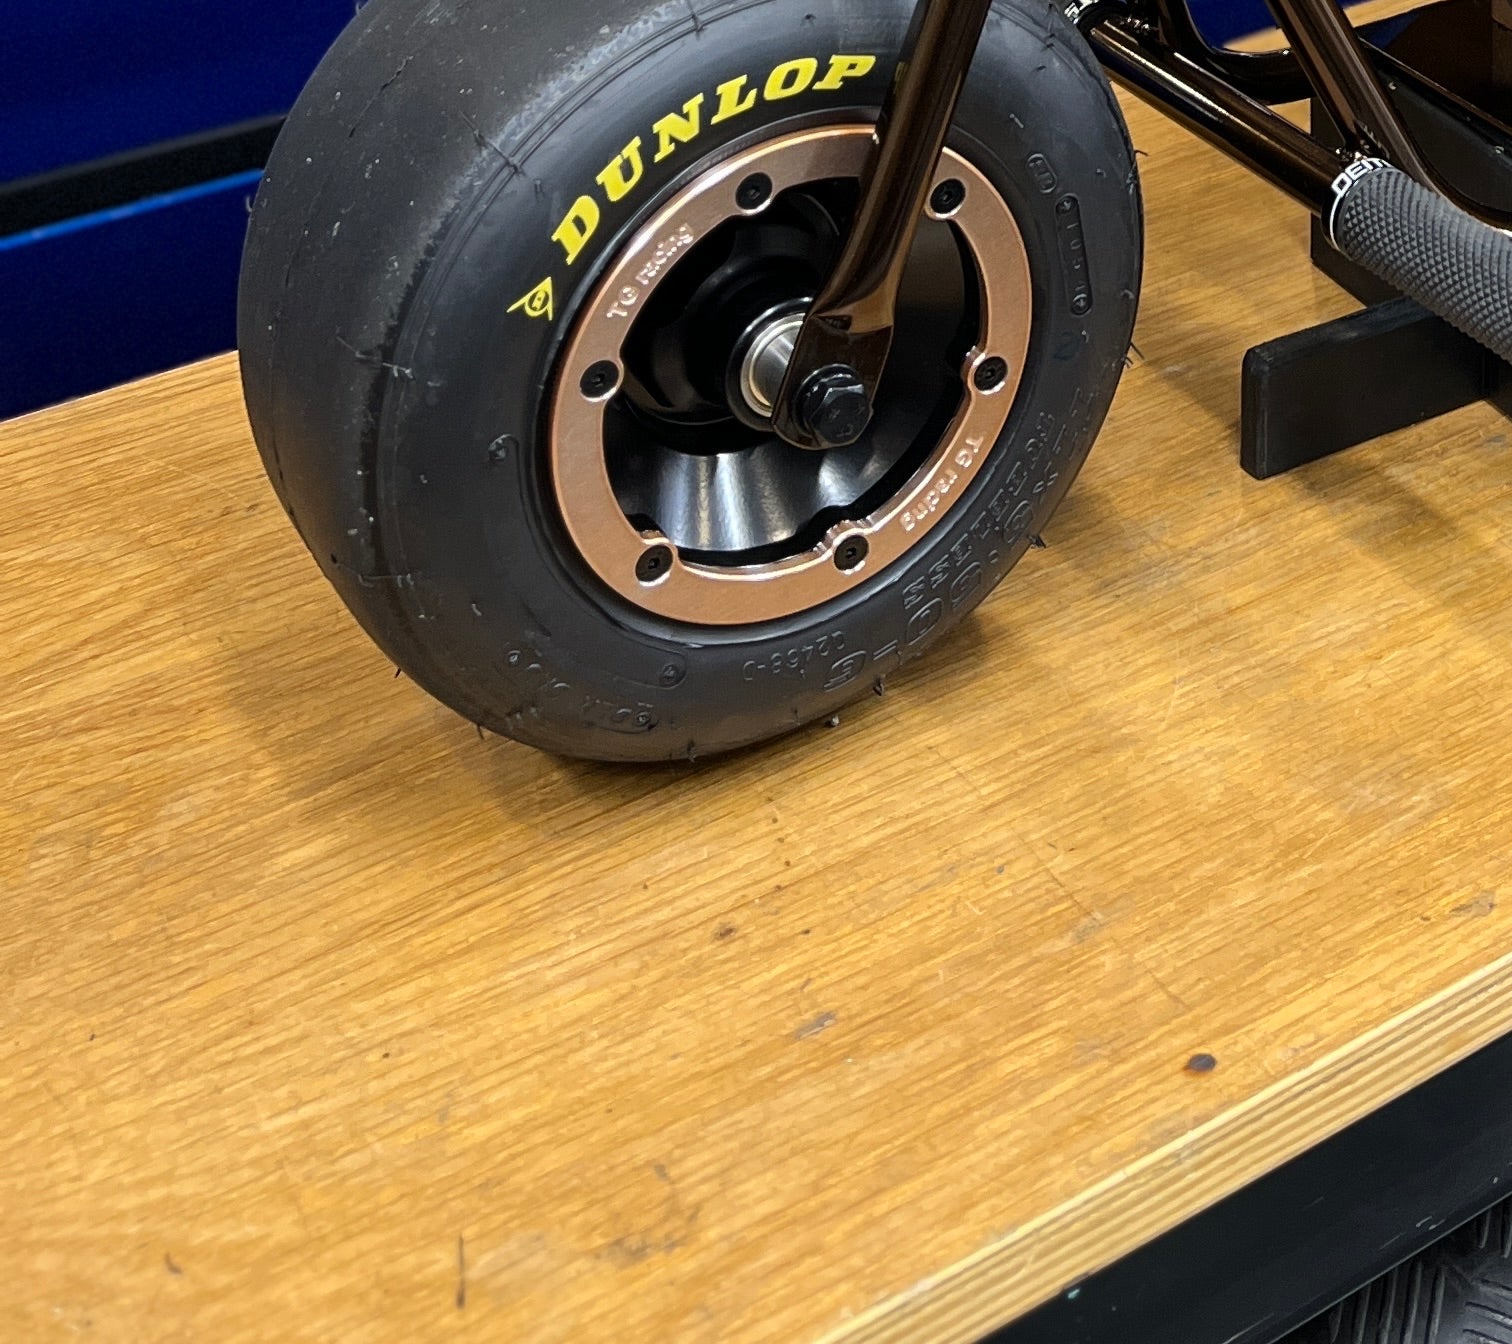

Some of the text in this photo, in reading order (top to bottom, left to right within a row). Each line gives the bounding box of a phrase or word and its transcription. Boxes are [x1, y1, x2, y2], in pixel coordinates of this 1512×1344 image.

[551, 53, 877, 265] DUNLOP
[606, 223, 694, 318] TG racing
[899, 435, 984, 532] TG racing
